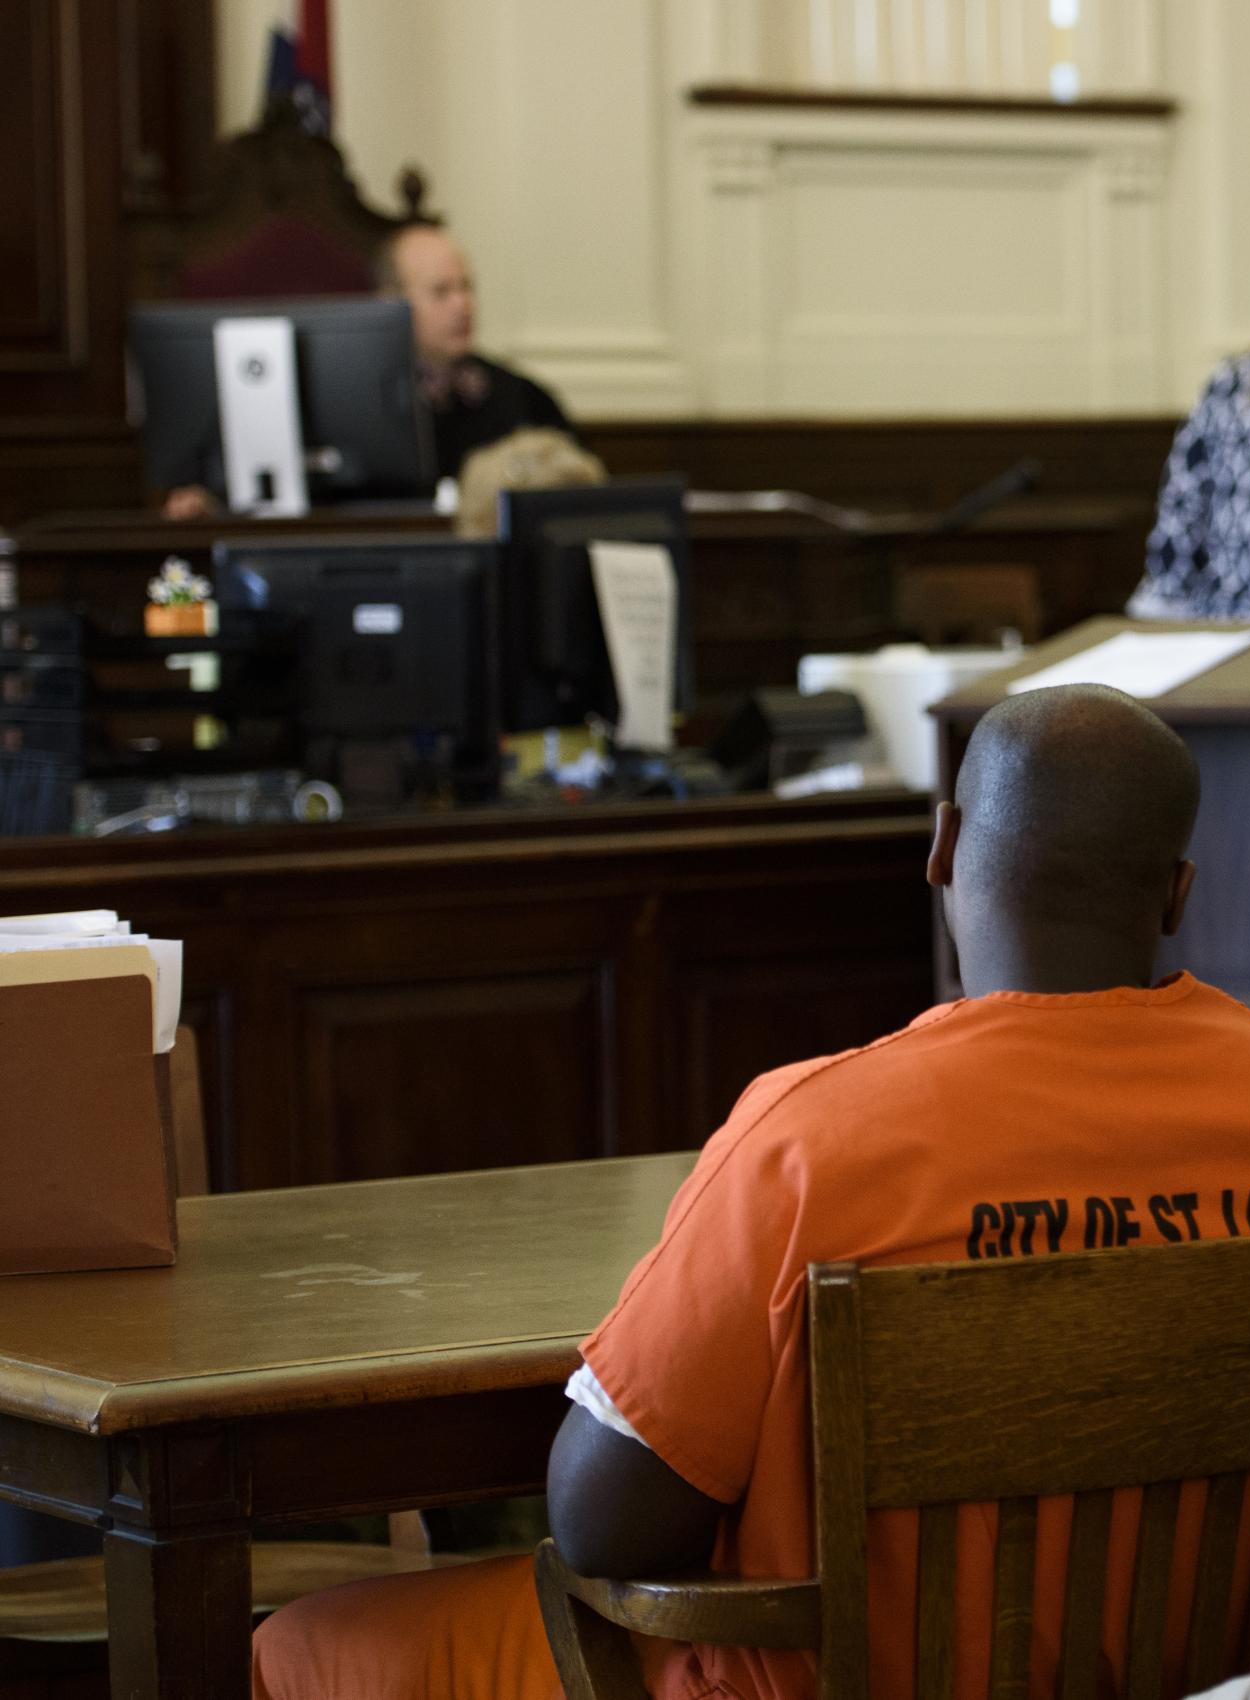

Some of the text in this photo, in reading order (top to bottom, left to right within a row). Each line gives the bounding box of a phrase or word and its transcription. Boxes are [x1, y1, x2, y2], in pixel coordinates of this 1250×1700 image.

[967, 1198, 1069, 1261] CITY
[1083, 1196, 1142, 1250] OF
[1147, 1192, 1200, 1244] ST
